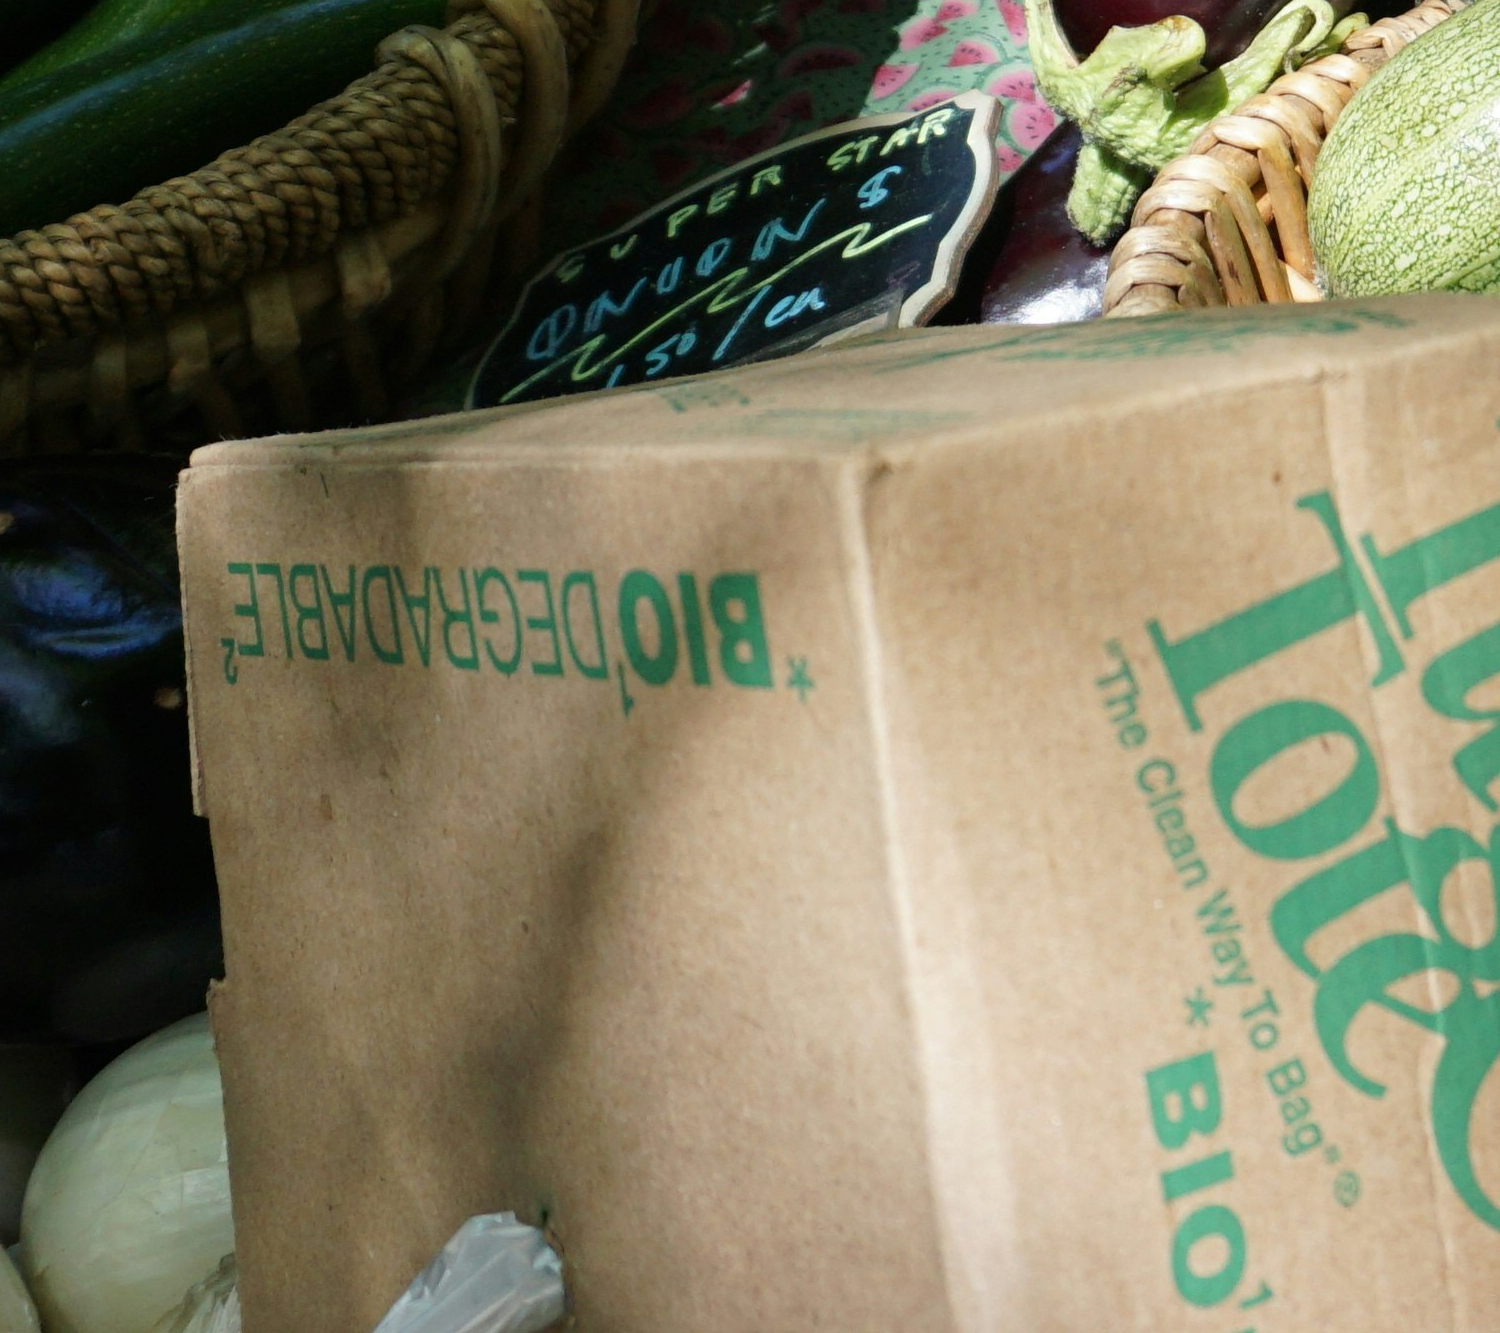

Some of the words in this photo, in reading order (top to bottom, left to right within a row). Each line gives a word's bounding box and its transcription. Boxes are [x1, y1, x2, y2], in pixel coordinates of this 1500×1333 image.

[553, 163, 783, 285] SUPER
[825, 107, 957, 173] STAR
[1134, 757, 1209, 890] Clean
[1195, 886, 1254, 988] Way
[1239, 988, 1281, 1051] To
[1144, 488, 1463, 1100] Tote
